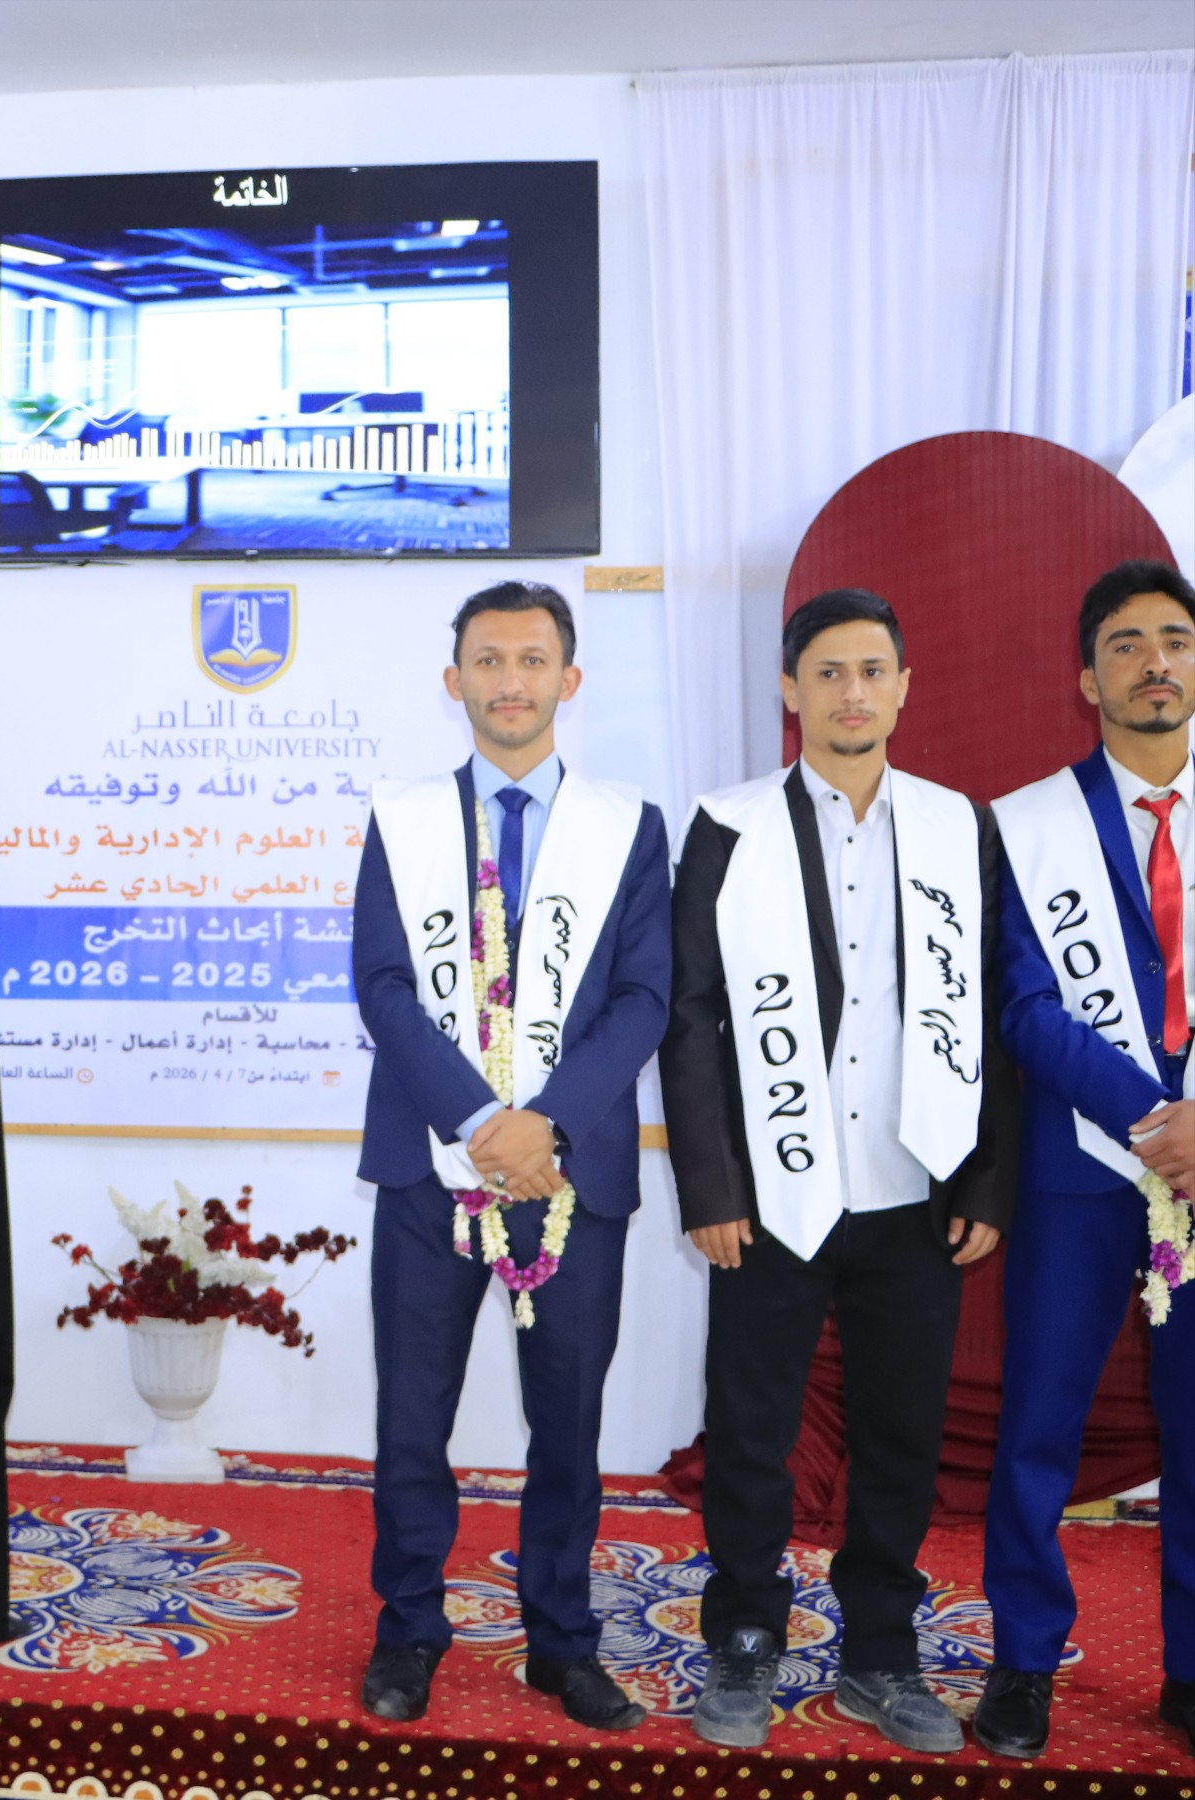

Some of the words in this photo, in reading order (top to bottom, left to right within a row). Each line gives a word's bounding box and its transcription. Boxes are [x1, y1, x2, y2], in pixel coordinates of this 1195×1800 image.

[213, 174, 288, 207] الخاتمة
[132, 699, 236, 734] الناصر
[248, 699, 360, 733] جامعة
[102, 738, 229, 759] AL-NASSER
[235, 737, 382, 759] UNIVERSITY
[44, 772, 181, 805] وتوفيقه
[197, 766, 256, 797] الله
[272, 777, 317, 805] من
[96, 825, 220, 859] الإدارية
[235, 826, 326, 856] العلوم
[41, 872, 109, 900] عشر
[119, 873, 220, 902] الحادي
[231, 874, 320, 904] العلمي
[908, 879, 962, 937] محمد
[83, 916, 188, 954] التخرج
[197, 911, 283, 947] أبحاث
[536, 895, 578, 964] أحمد
[3, 967, 21, 995] م
[29, 960, 130, 986] 2026
[171, 961, 273, 988] 2025
[423, 909, 460, 1046] 202
[927, 934, 967, 1002] حسين
[203, 1004, 278, 1025] للأقسام
[51, 1033, 97, 1052] إدارة
[121, 1031, 178, 1051] أعمال
[186, 1034, 232, 1054] إدارة
[257, 1034, 331, 1054] محاسبة
[1, 1066, 23, 1078] العا
[28, 1066, 73, 1079] الساعة
[163, 1067, 197, 1079] 2026
[753, 974, 814, 1172] 2026
